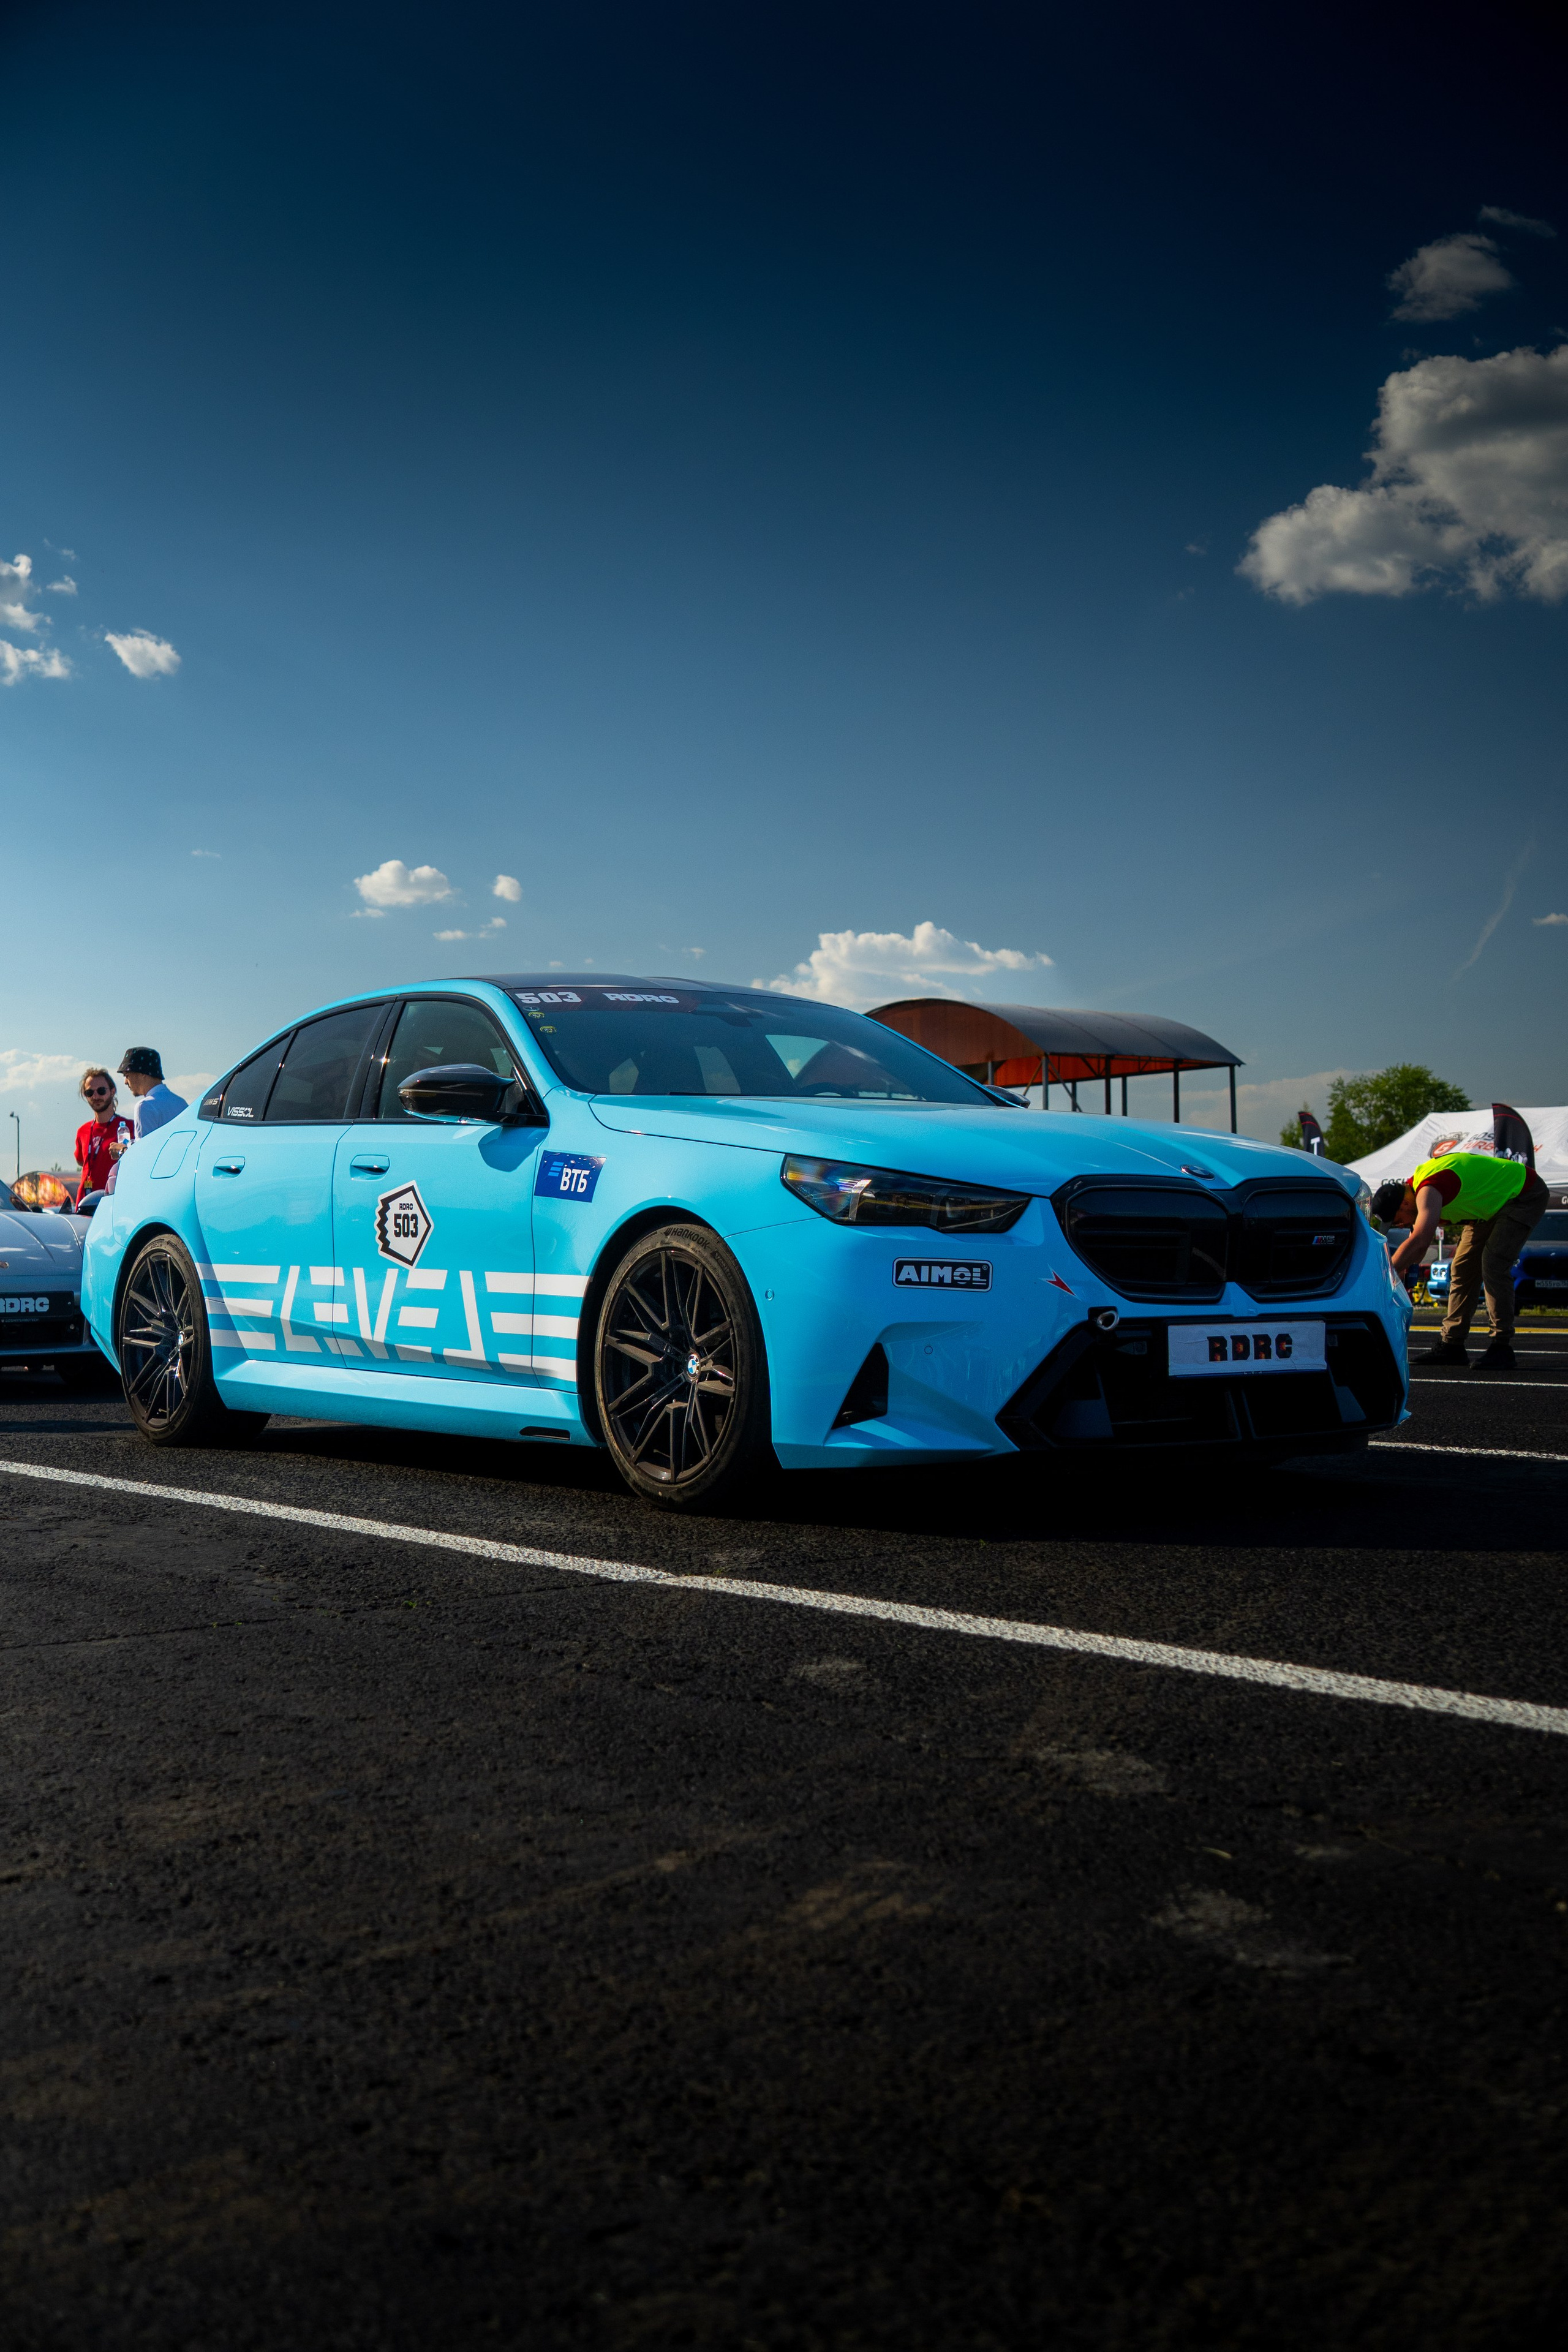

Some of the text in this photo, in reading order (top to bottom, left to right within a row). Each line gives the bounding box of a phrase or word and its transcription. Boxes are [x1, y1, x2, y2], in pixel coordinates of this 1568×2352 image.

[515, 992, 679, 1004] 503 RDRC
[227, 1106, 254, 1118] VISSOL
[560, 1167, 590, 1193] ВТБ
[394, 1213, 418, 1238] 503
[897, 1265, 987, 1285] AIMOL
[1207, 1333, 1292, 1362] RDRC
